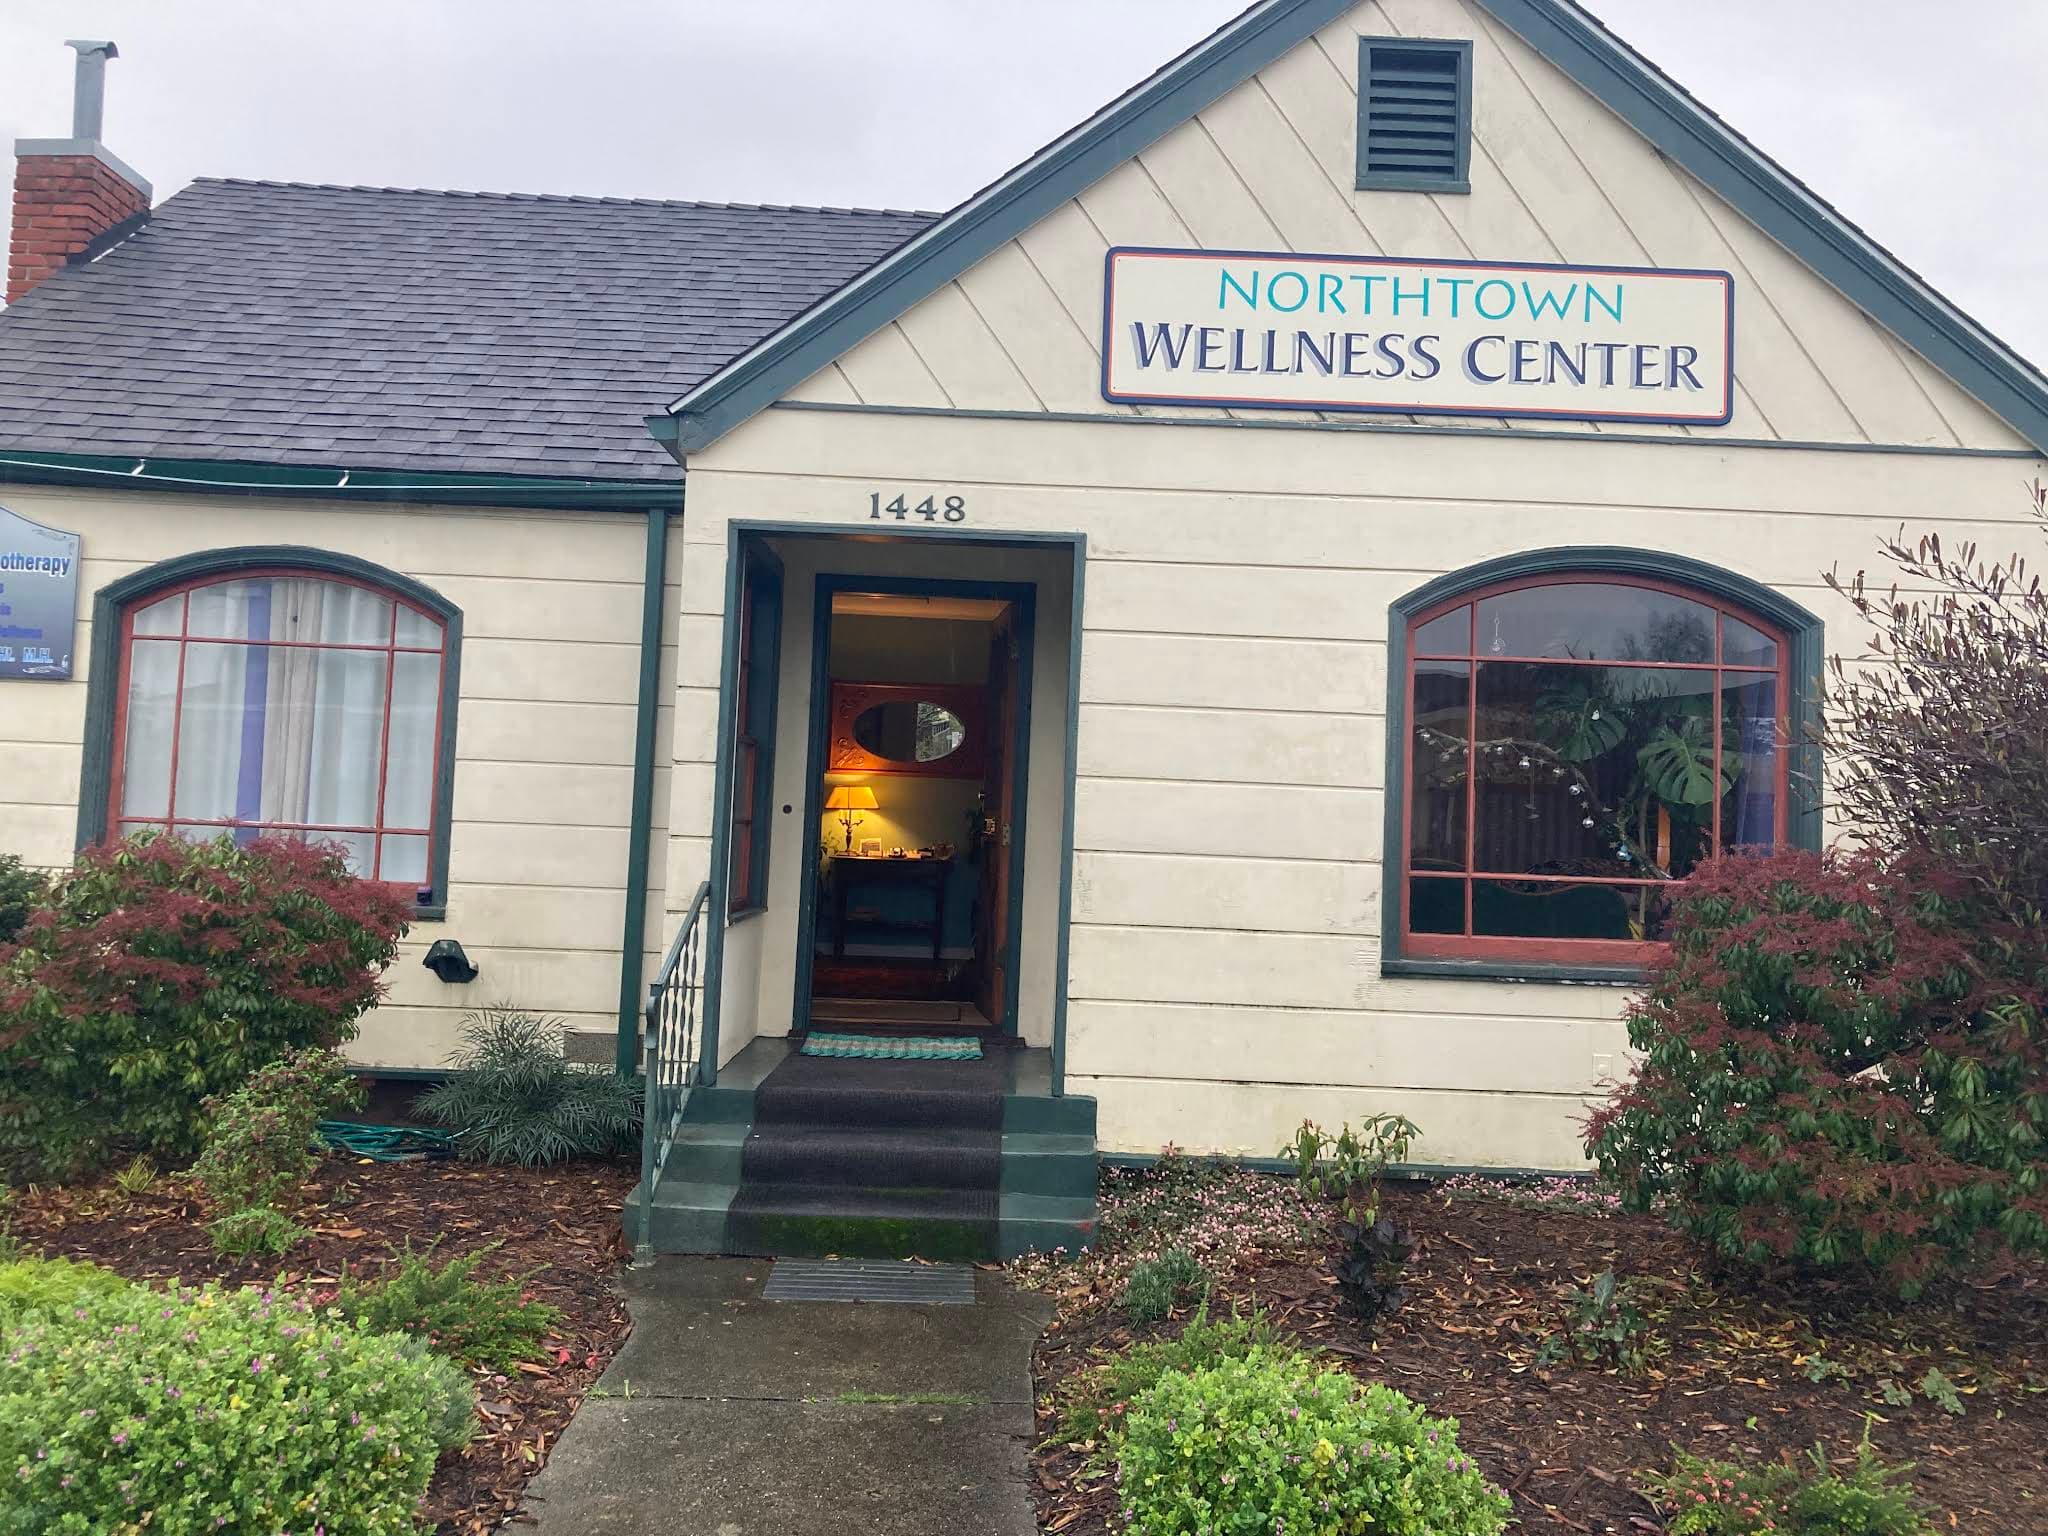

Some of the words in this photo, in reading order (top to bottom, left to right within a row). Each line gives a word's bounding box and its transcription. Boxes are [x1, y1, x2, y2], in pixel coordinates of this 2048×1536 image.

[1219, 268, 1624, 323] NORTHTOWN
[1131, 321, 1440, 379] WELLNESS
[1463, 334, 1704, 390] CENTER
[870, 492, 966, 522] 1448
